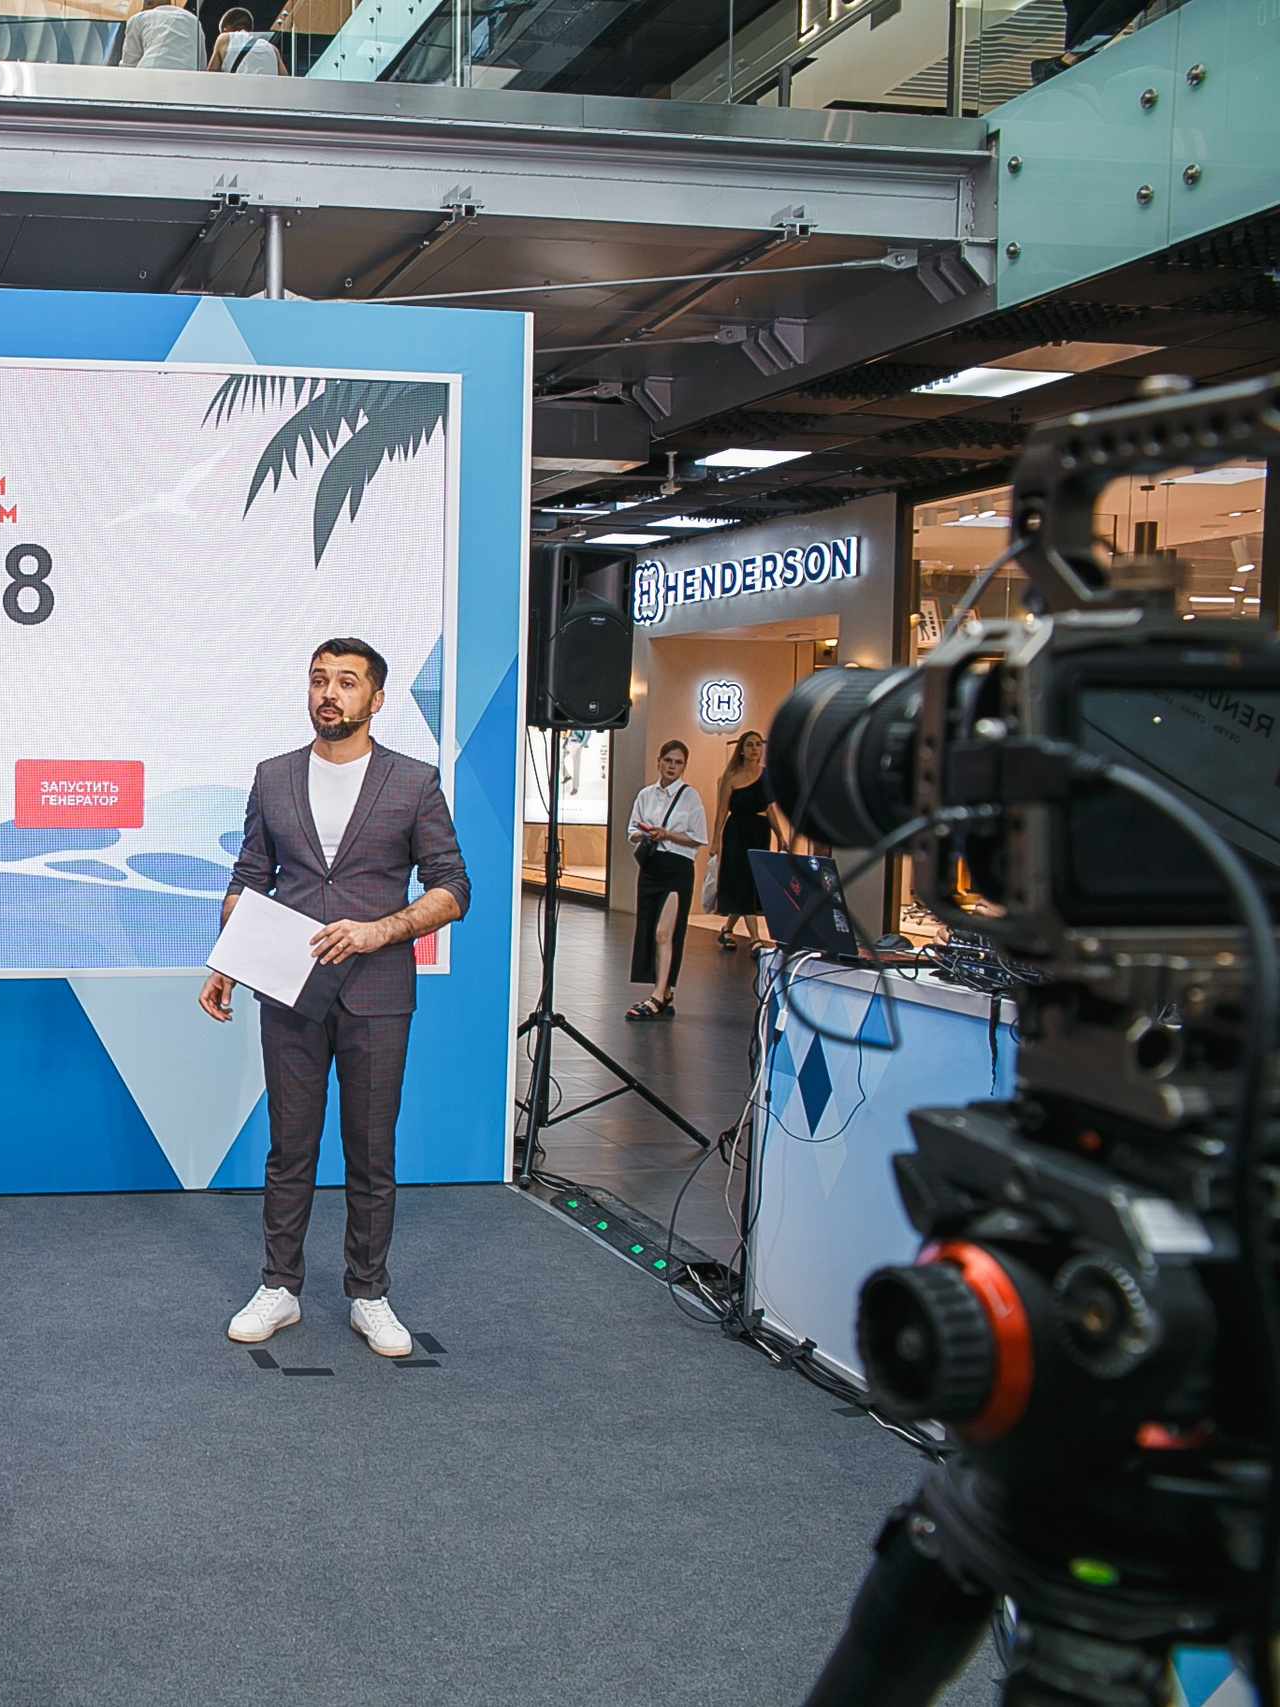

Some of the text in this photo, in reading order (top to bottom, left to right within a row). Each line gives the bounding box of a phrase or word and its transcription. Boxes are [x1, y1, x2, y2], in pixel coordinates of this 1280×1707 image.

[665, 536, 859, 606] HENDERSON
[40, 781, 119, 793] ЗАПУСТИТЬ
[41, 795, 119, 806] ГЕНЕРАТОР
